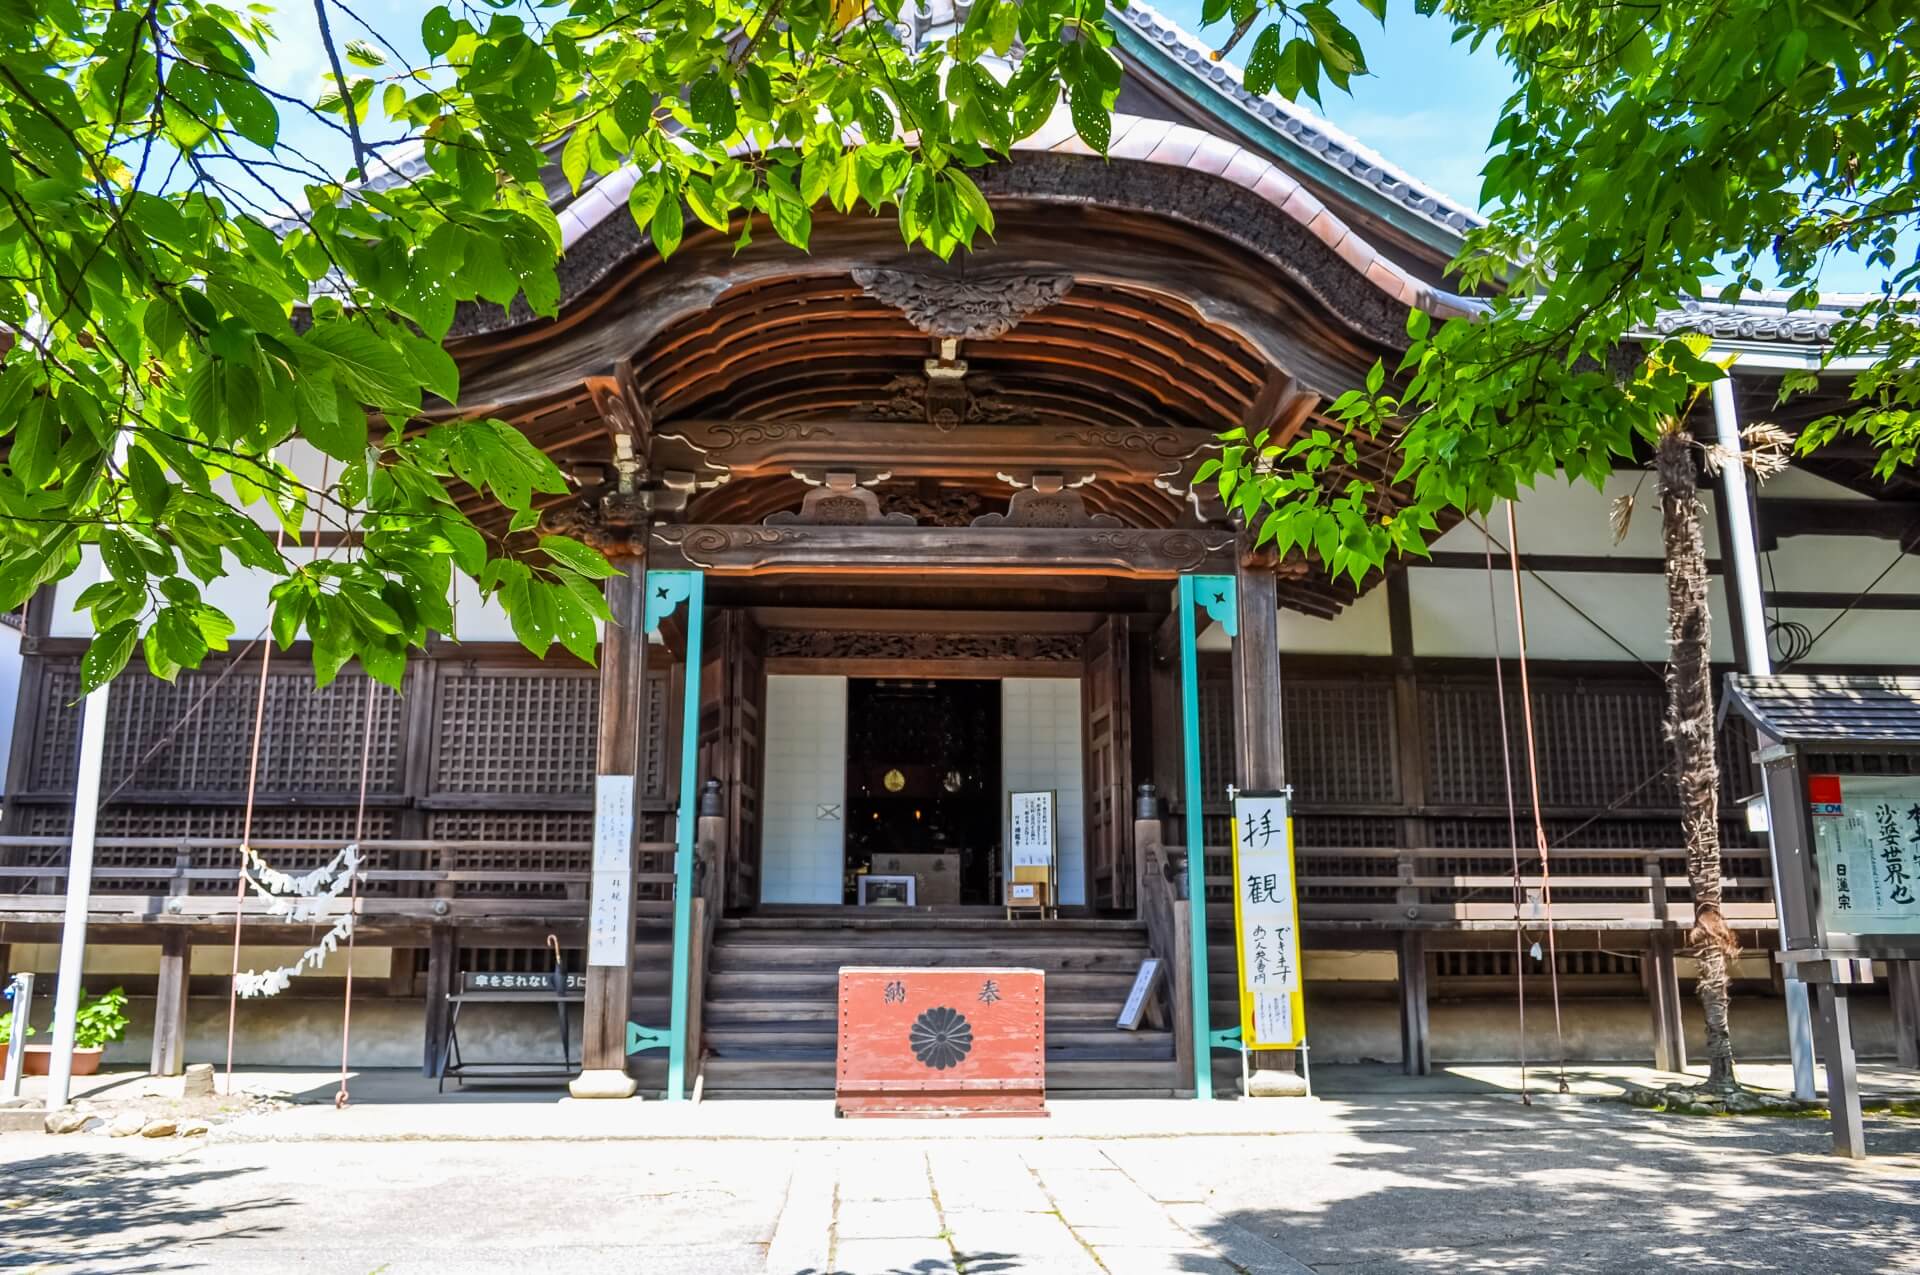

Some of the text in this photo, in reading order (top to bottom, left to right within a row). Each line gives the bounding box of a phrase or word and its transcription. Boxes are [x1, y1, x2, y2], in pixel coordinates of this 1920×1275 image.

[1242, 808, 1285, 904] 拝観
[1837, 863, 1852, 910] 日蓮宗
[1272, 926, 1292, 985] できます
